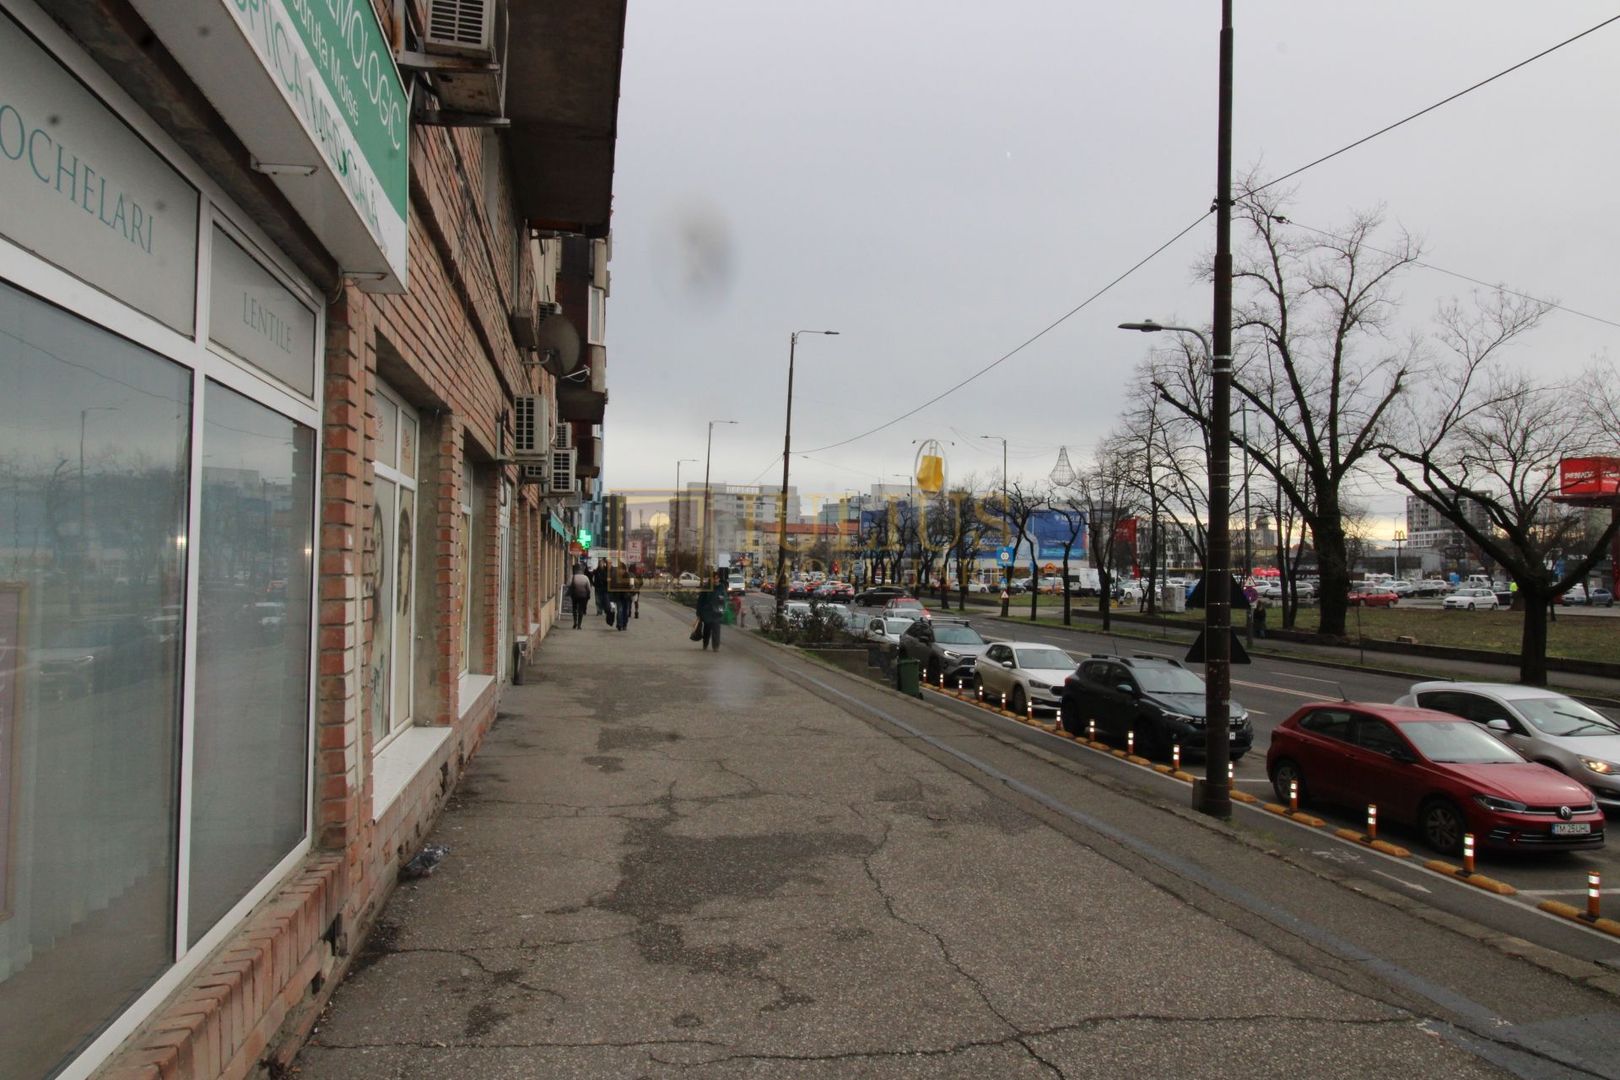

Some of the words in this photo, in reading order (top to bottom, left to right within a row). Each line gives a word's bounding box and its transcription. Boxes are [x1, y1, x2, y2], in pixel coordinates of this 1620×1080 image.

[331, 47, 359, 126] Moise
[0, 105, 154, 255] OCHELARI
[242, 292, 292, 353] LENTILE
